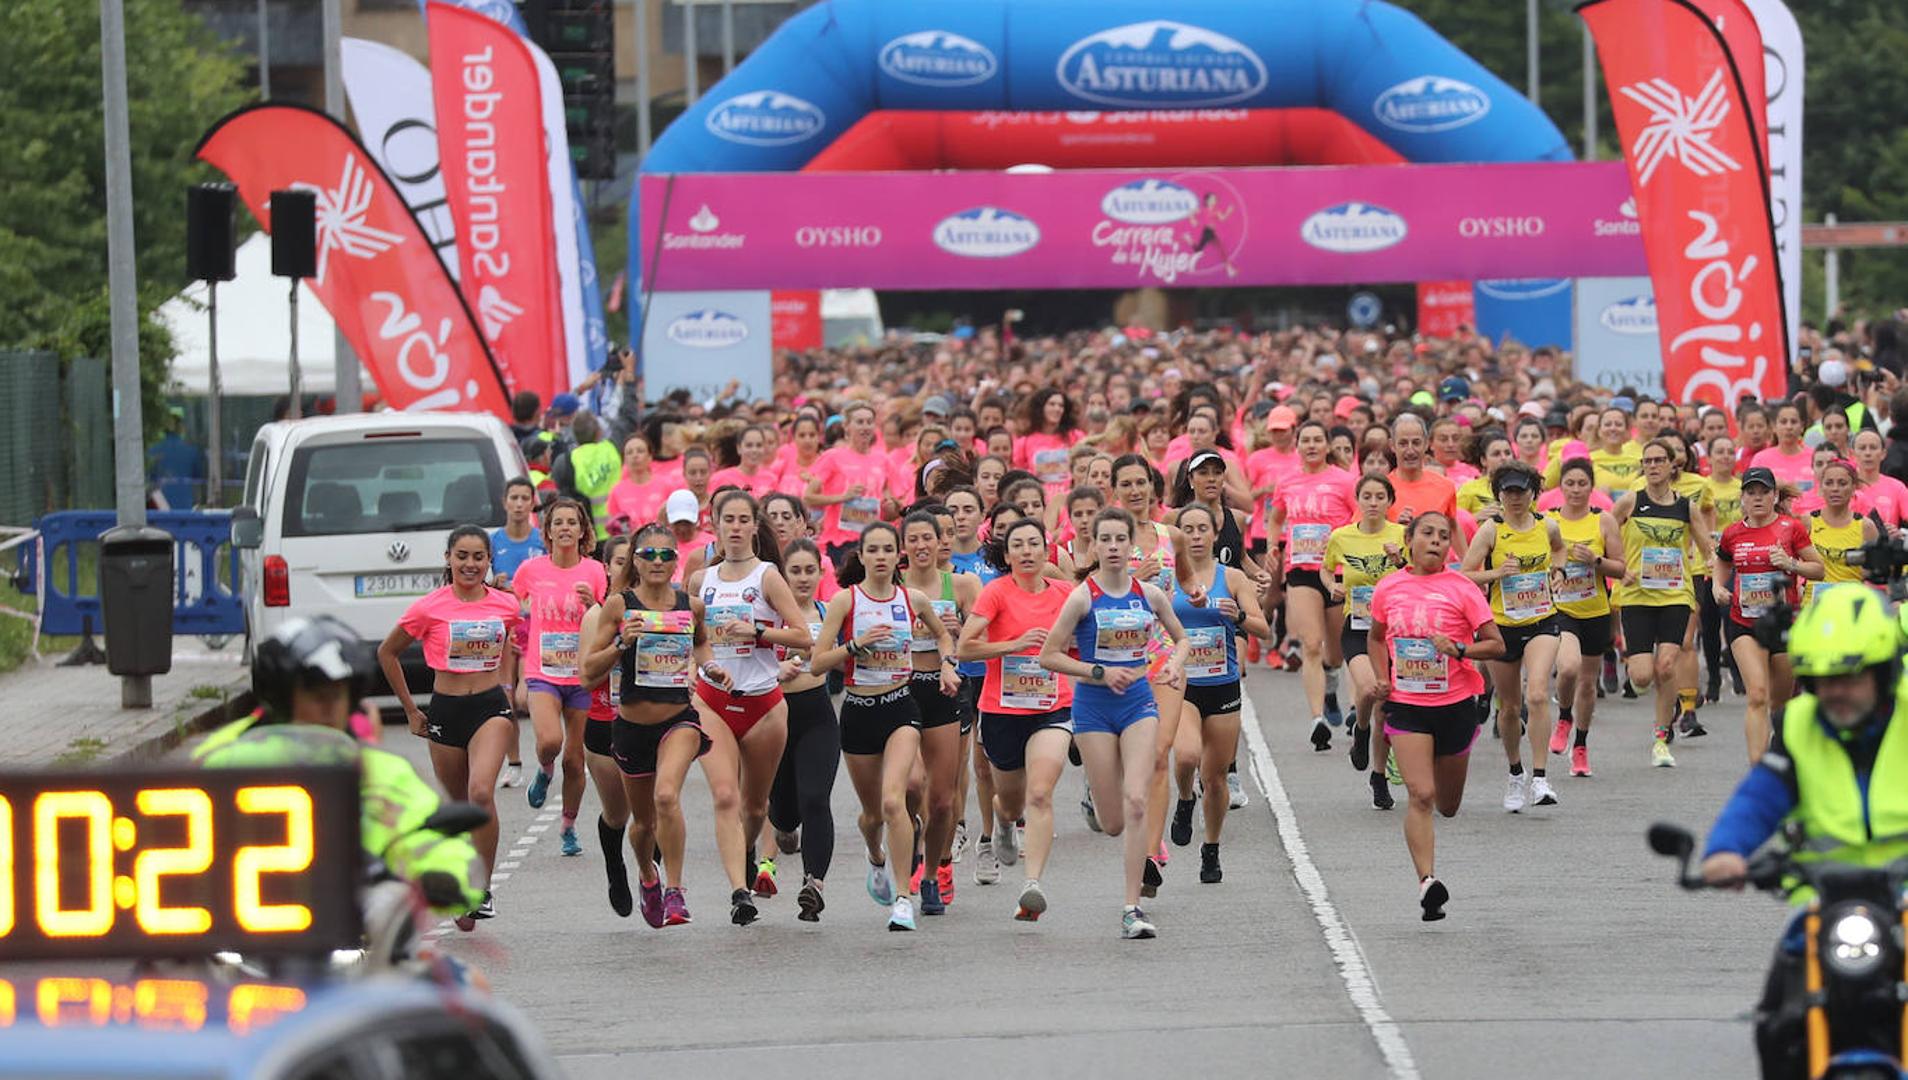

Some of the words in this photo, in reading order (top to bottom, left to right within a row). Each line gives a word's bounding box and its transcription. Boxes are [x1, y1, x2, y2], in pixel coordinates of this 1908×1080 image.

[888, 49, 988, 75] ASTURIANA
[1074, 53, 1250, 93] ASTURIANA
[1382, 96, 1479, 120] ASTURIANA
[718, 108, 816, 132] ASTURIANA
[1110, 197, 1191, 213] ASTURIANA
[795, 226, 883, 248] OYSHO
[940, 225, 1032, 245] ASTURIANA
[1092, 220, 1175, 247] Carrera
[1310, 220, 1400, 242] ASTURIANA
[1458, 217, 1545, 238] OYSHO
[662, 233, 747, 249] Santander
[1137, 242, 1203, 284] Mujer
[1517, 591, 1537, 600] 016
[1115, 630, 1139, 640] 016
[466, 641, 490, 650] 016
[872, 650, 898, 661] 016
[654, 654, 678, 665] 016
[1405, 660, 1430, 670] 016
[1018, 676, 1044, 687] 016
[845, 694, 876, 706] PRO
[880, 686, 910, 704] NIKE
